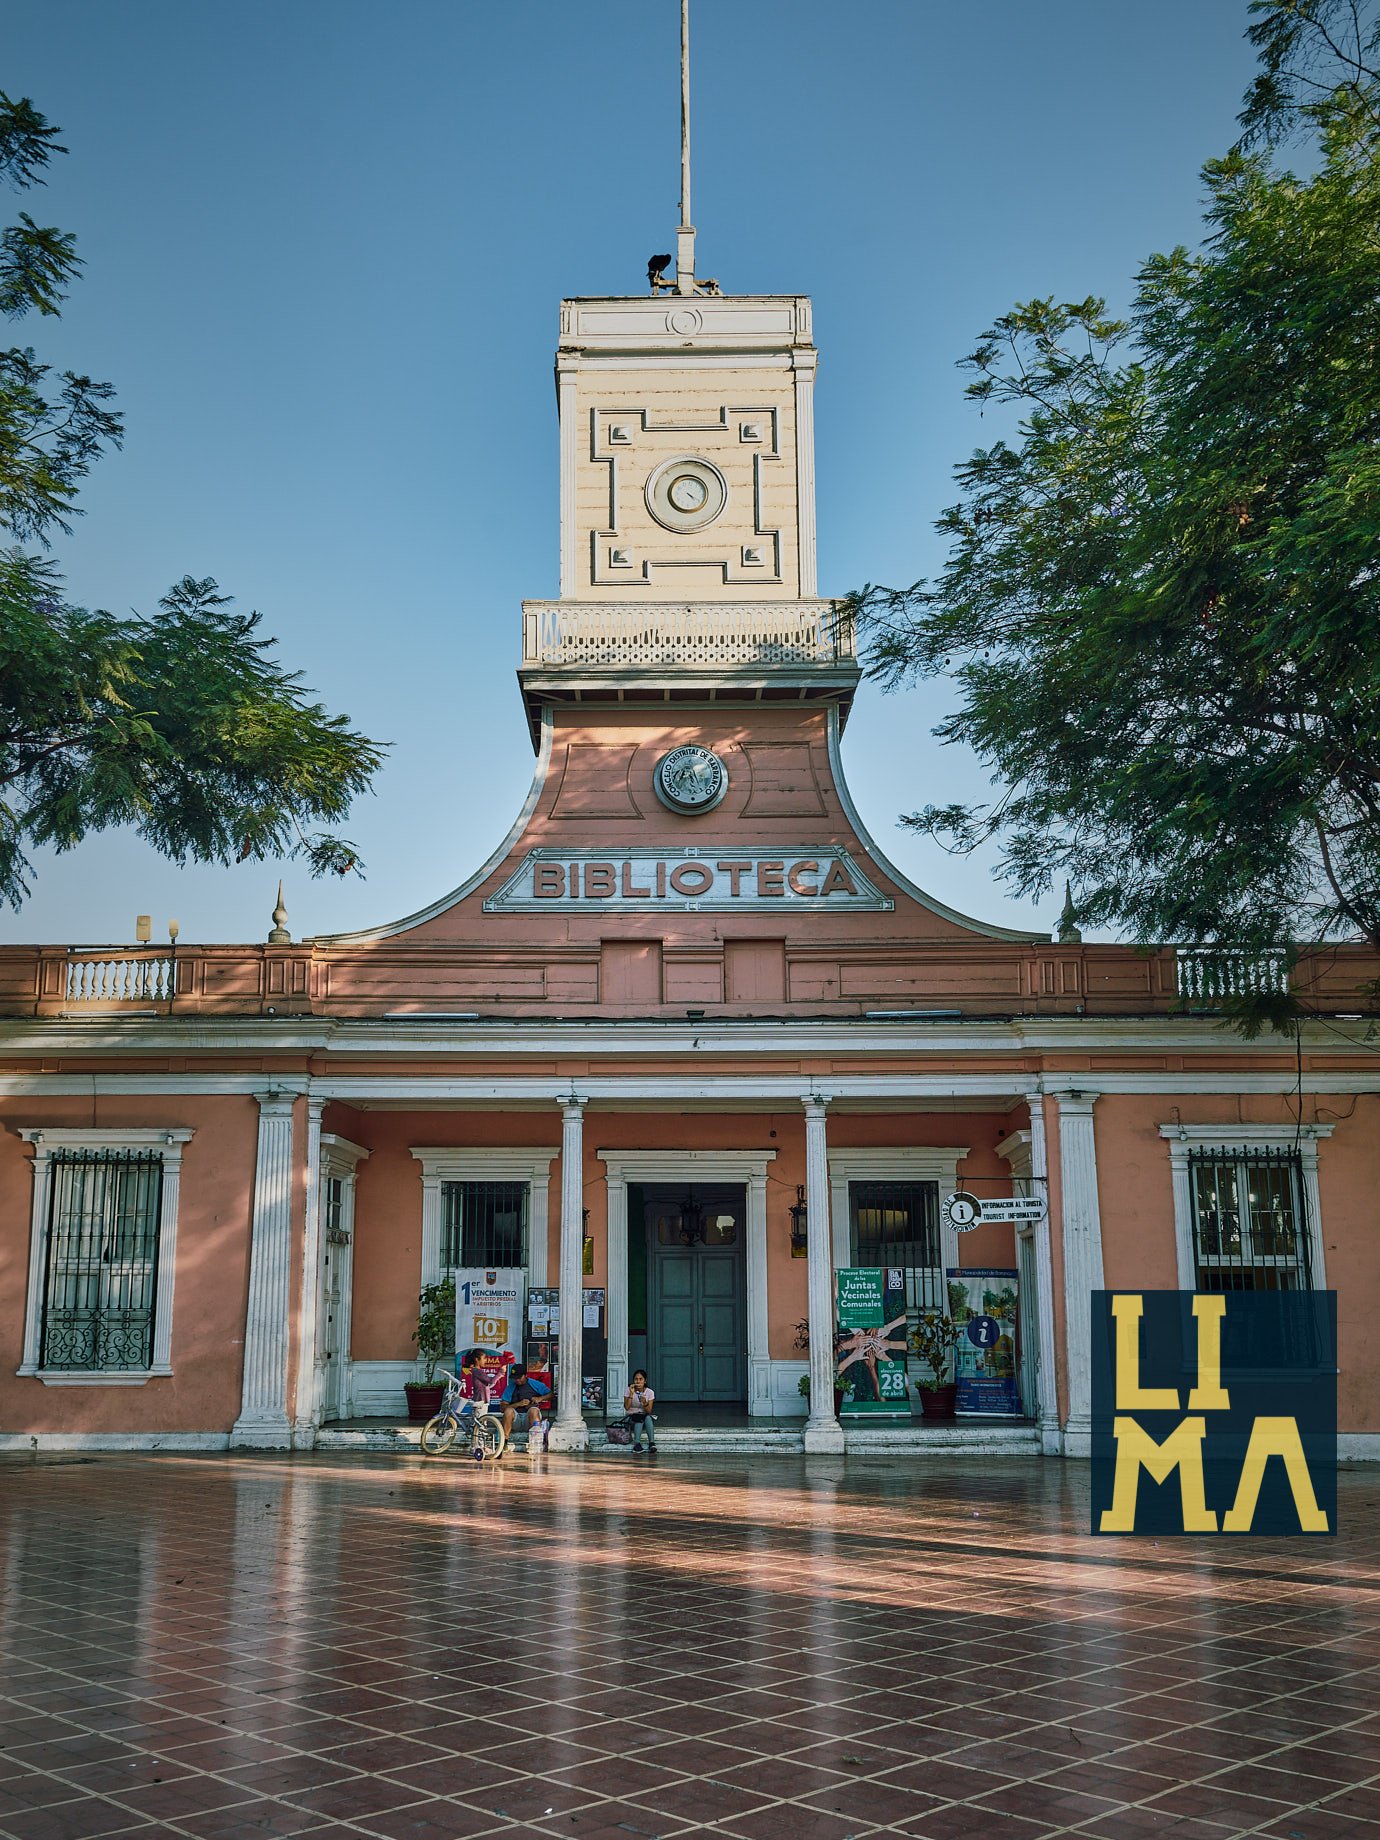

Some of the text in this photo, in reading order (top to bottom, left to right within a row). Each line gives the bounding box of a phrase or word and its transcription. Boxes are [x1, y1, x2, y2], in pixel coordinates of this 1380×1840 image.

[664, 749, 719, 797] CONCEJO DISTRITAL DE BARRANCO
[533, 861, 858, 898] BIBLIOTECA
[981, 1201, 1014, 1209] INFORMACION
[1007, 1211, 1041, 1219] INFORMATION
[844, 1280, 877, 1290] Juntas
[841, 1290, 881, 1299] Vecinales
[841, 1300, 882, 1308] Comunales
[881, 1373, 904, 1390] 28
